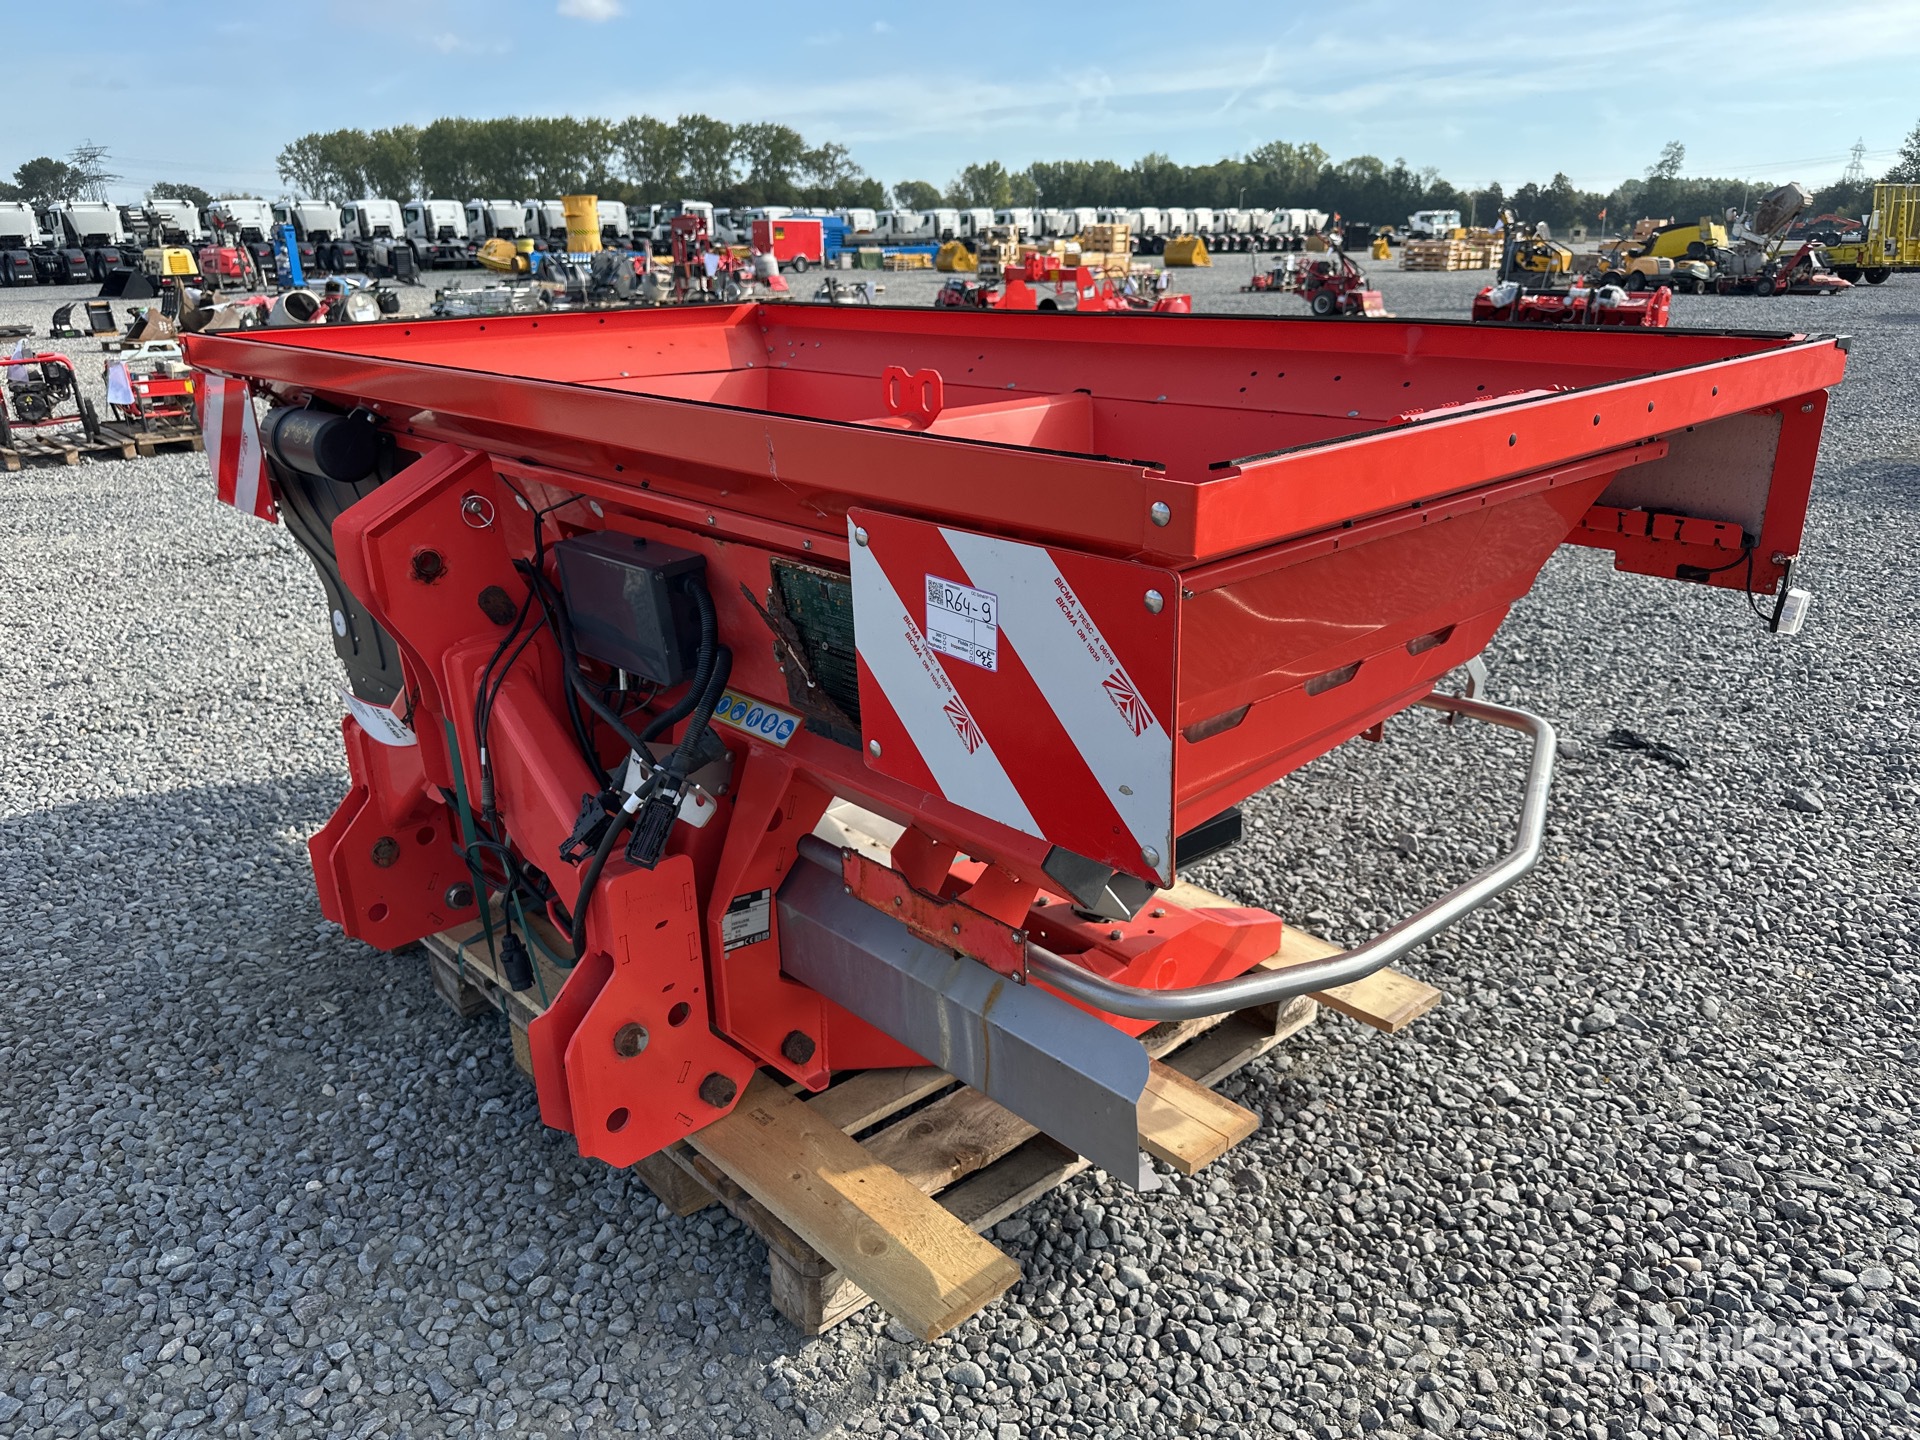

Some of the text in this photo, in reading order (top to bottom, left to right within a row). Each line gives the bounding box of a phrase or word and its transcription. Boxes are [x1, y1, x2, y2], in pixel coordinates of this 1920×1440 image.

[945, 589, 992, 623] R64-9
[1054, 577, 1076, 607] BICMA
[1100, 645, 1115, 665] 06016
[1056, 597, 1100, 662] BICMA DIN 11030
[903, 615, 920, 641] BICMA
[940, 674, 952, 692] 06016
[905, 632, 922, 658] BICMA
[930, 673, 941, 689] 11030
